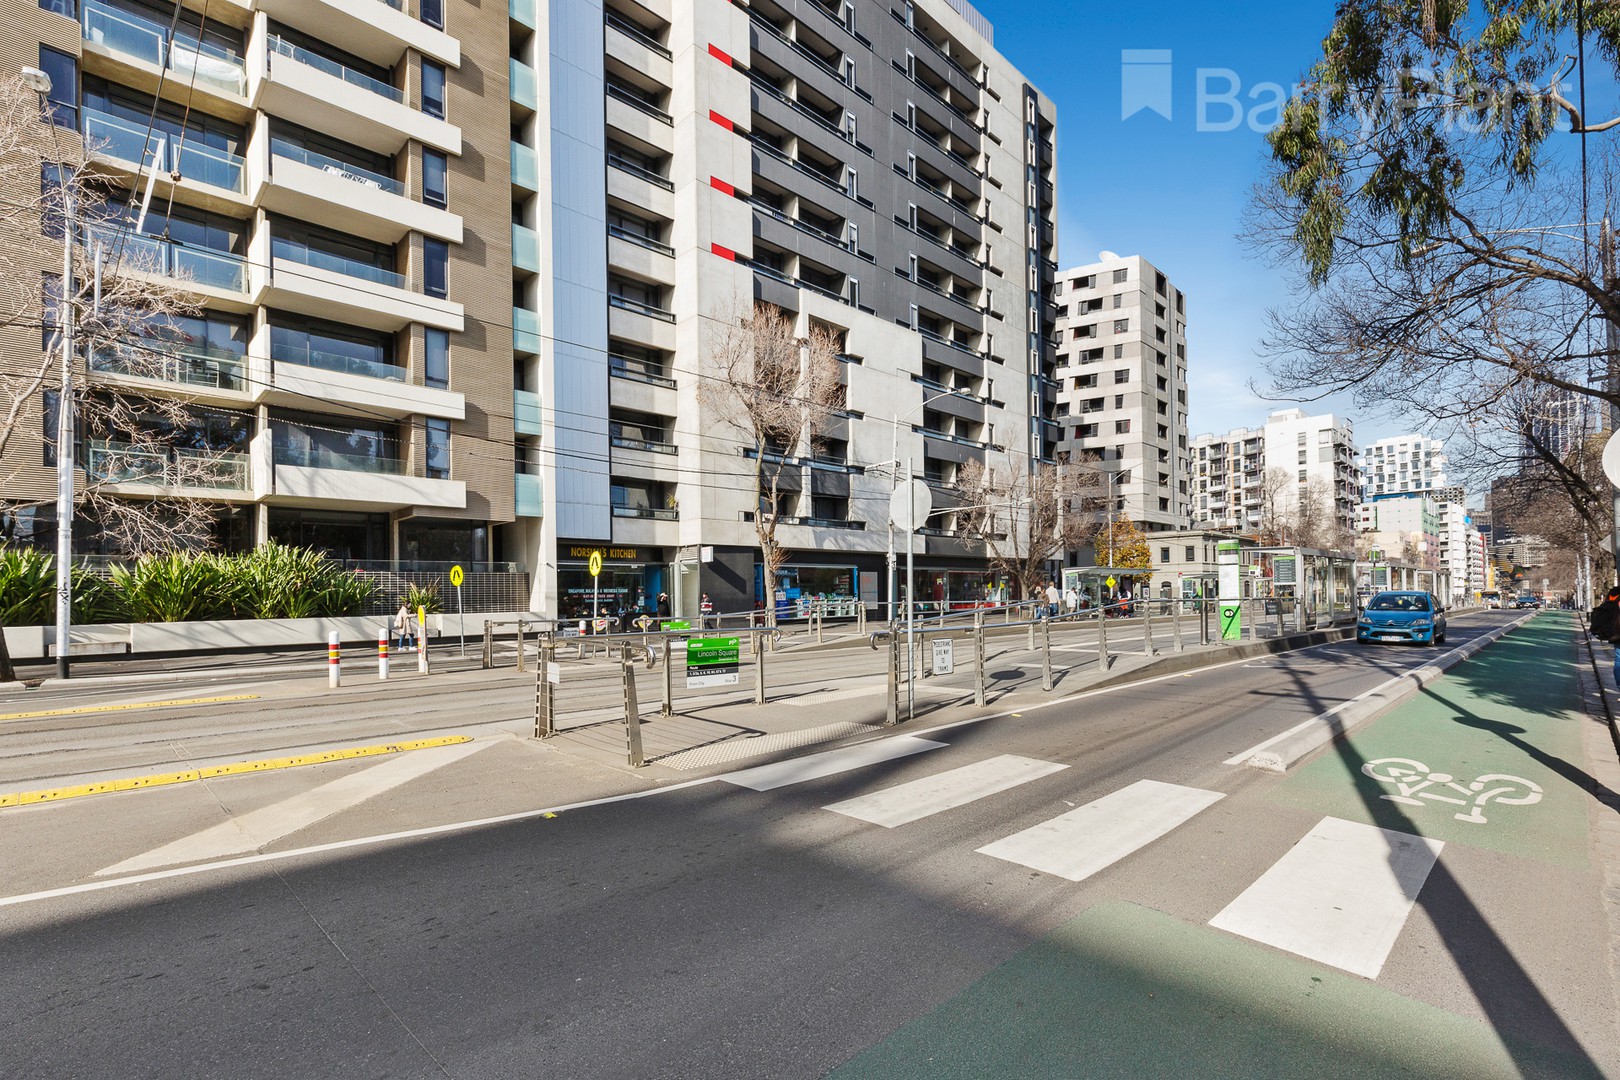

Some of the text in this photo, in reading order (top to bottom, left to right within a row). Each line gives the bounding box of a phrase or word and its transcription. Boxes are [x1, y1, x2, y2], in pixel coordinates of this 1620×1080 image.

[570, 546, 637, 559] NORSI'S KITCHEN
[697, 648, 737, 658] Lincoln Square
[732, 674, 737, 682] 3
